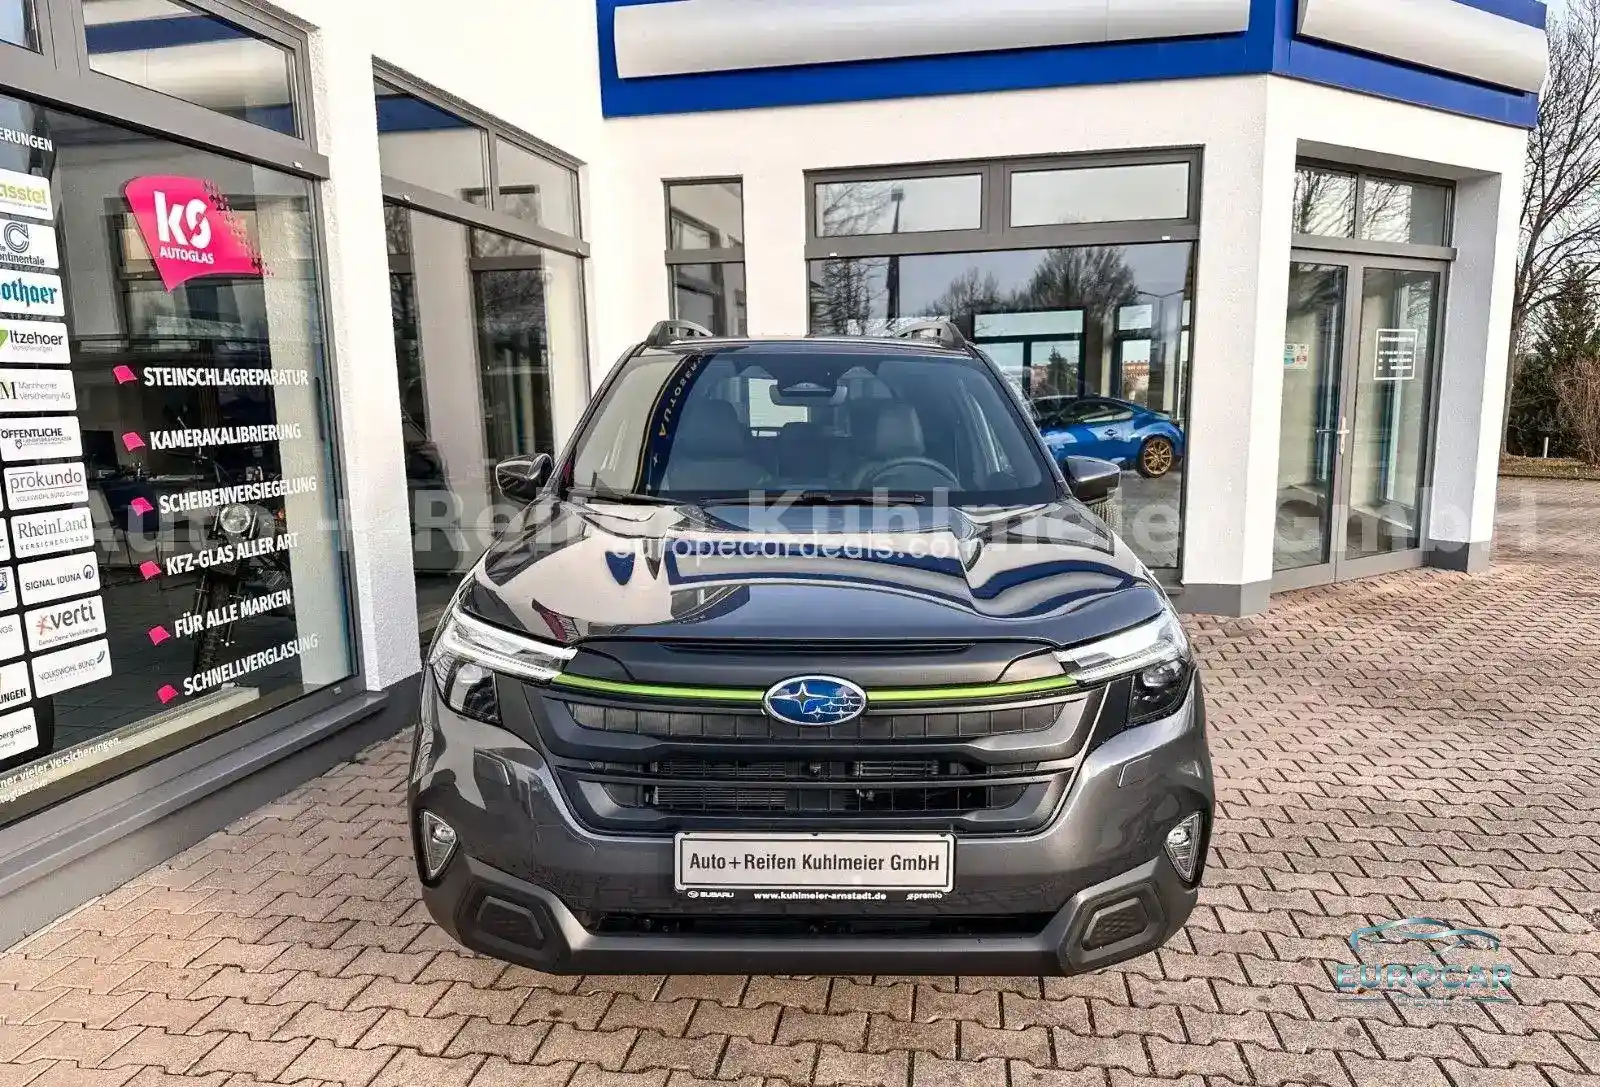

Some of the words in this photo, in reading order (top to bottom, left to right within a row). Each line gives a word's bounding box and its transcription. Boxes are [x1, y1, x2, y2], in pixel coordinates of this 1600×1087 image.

[160, 246, 214, 264] AUTOGLAS
[0, 277, 57, 307] othaer
[9, 330, 63, 346] Itzehoer
[143, 367, 309, 387] STEINSCHLAGREPARATUR
[1, 427, 63, 439] ÖFFENTLICHE
[150, 423, 301, 450] KAMERAKALIBRIERUNG
[10, 468, 82, 493] prokundo
[159, 476, 317, 514] SCHEIBENVERSIEGELUNG
[17, 515, 88, 539] RheinLand
[166, 544, 235, 576] KFZ-GLAS
[237, 537, 274, 560] ALLER
[276, 532, 299, 551] ART
[25, 578, 56, 591] SIGNAL
[57, 573, 81, 585] IDUNA
[50, 600, 96, 629] verti
[174, 611, 204, 639] FÜR
[206, 603, 239, 630] ALLE
[240, 589, 292, 618] MARKEN
[183, 632, 319, 696] SCHNELLVERGLASUNG
[20, 763, 48, 781] vieler
[50, 737, 122, 768] Versicherungen.
[802, 853, 884, 871] Kuhlmeier
[890, 854, 940, 871] GmbH
[753, 891, 887, 900] www.kuhlmeier-arnstadt.de
